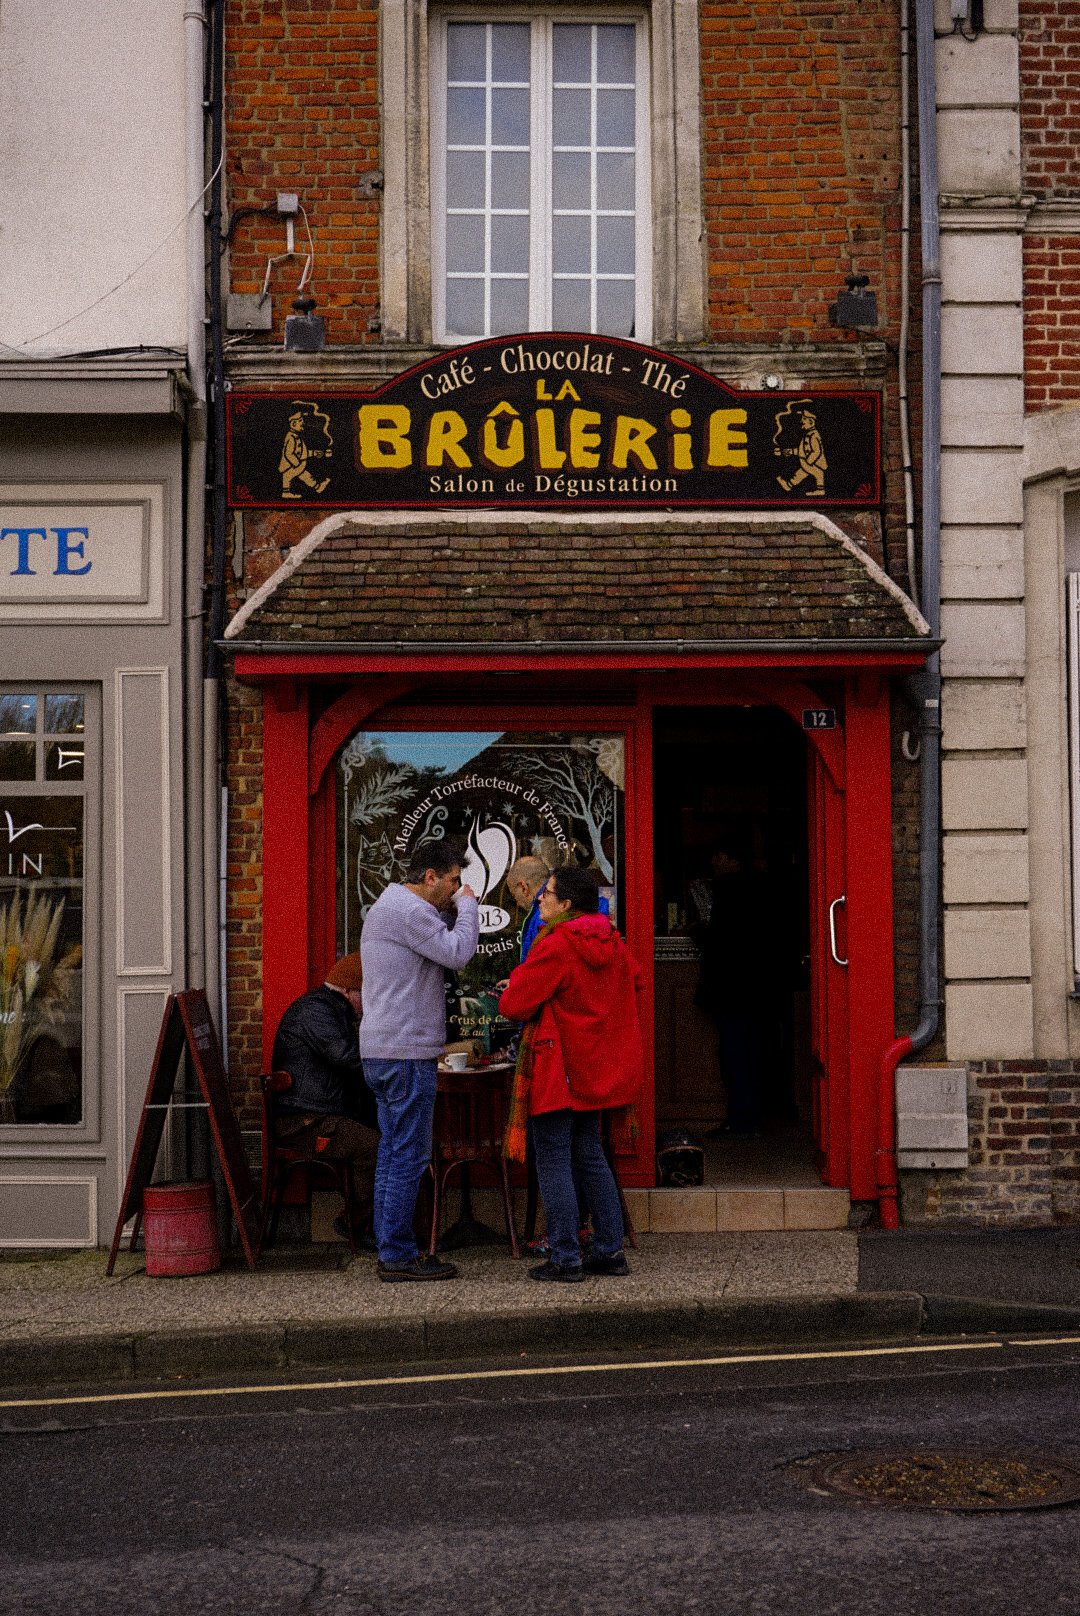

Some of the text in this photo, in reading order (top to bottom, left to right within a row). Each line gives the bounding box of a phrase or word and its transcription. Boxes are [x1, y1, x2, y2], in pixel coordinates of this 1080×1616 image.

[420, 357, 476, 400] Café
[500, 344, 614, 375] Chocolat
[641, 358, 690, 399] Thé
[536, 379, 581, 400] LA
[429, 474, 678, 497] Salon de Dégustation
[0, 527, 93, 576] TE
[811, 711, 827, 726] 12
[393, 774, 569, 852] Meilleur Torréfacteur de France
[449, 1014, 476, 1025] Crus
[478, 1014, 492, 1025] de
